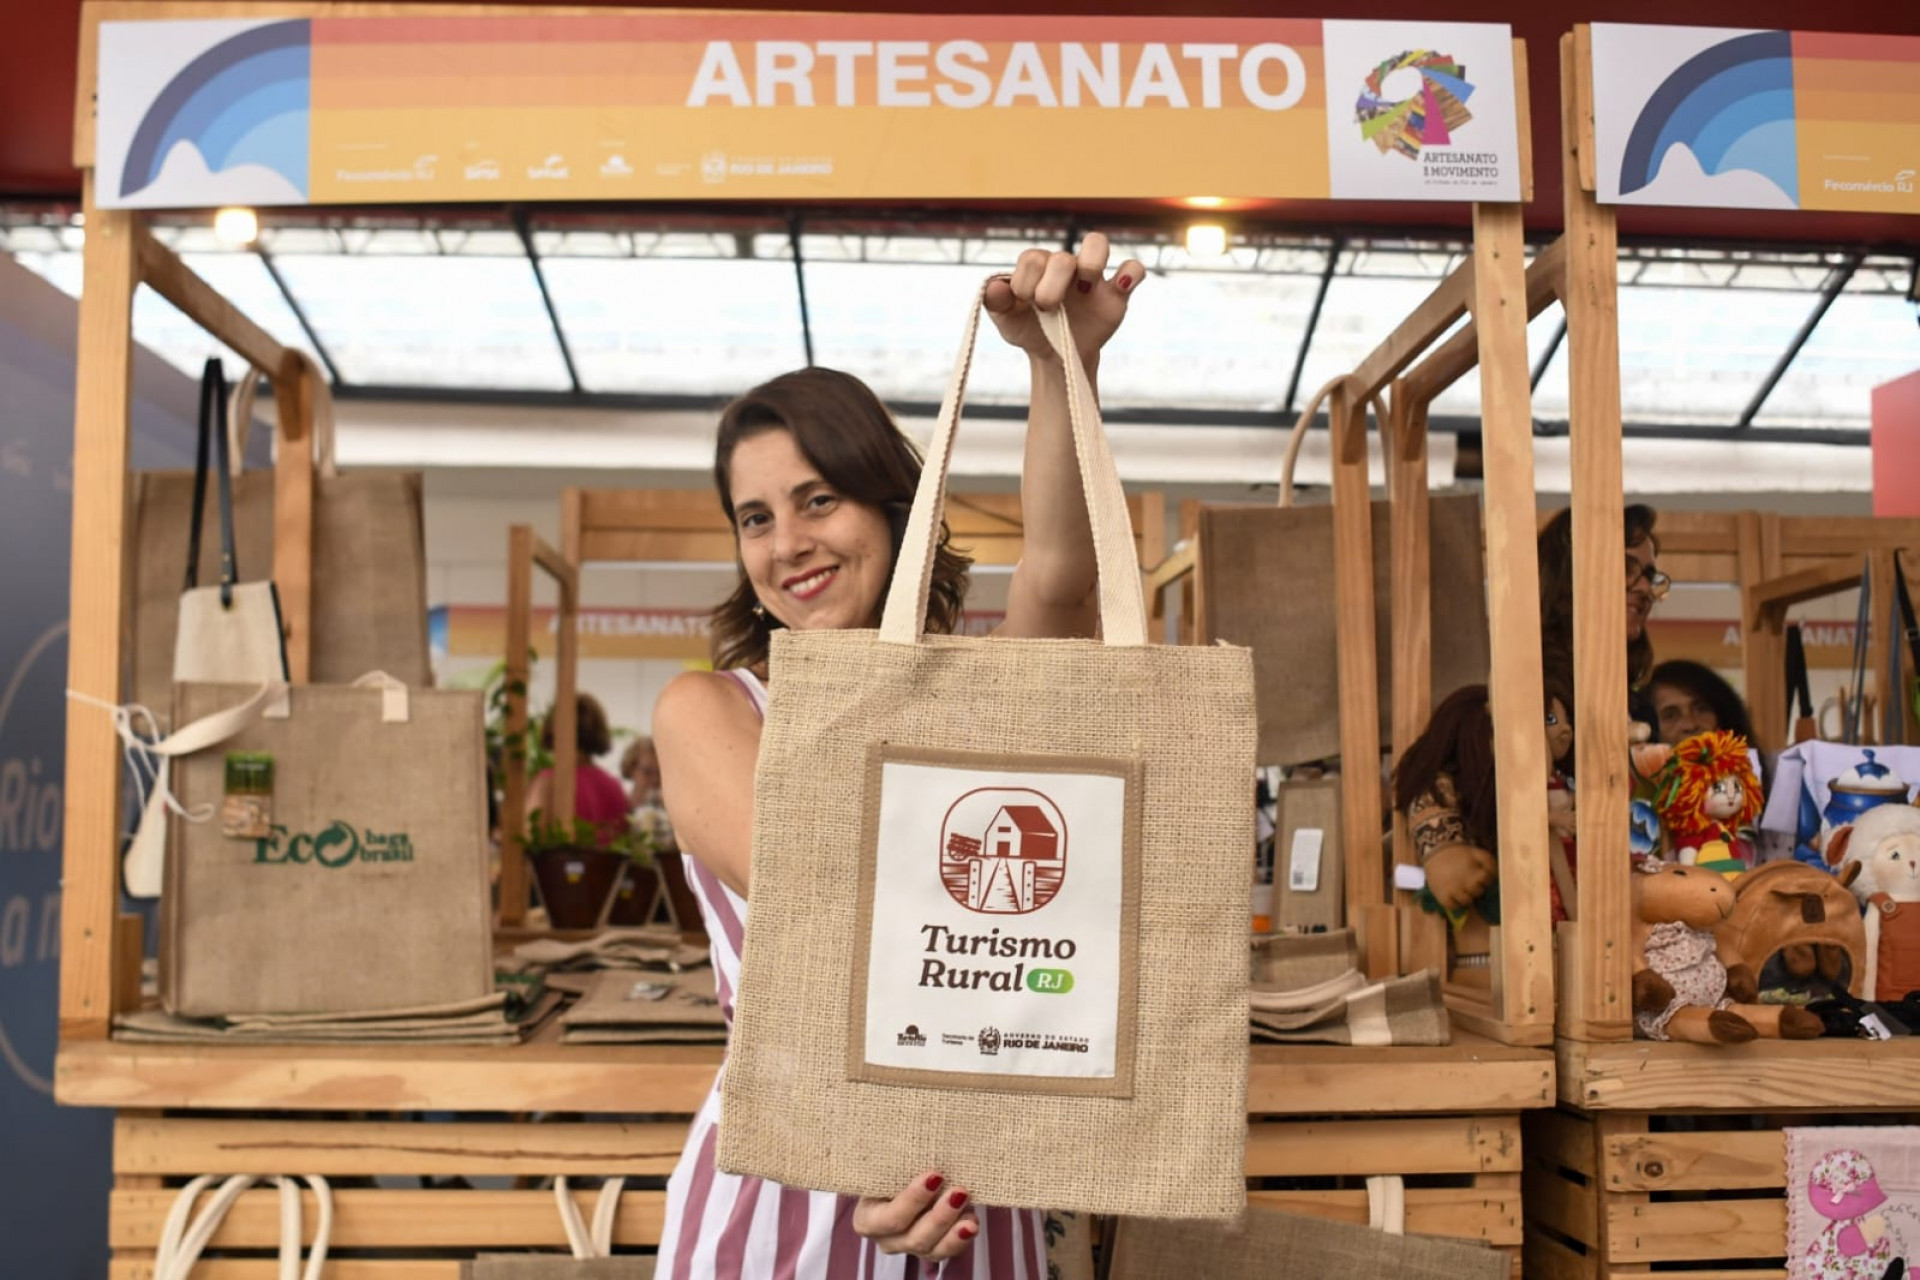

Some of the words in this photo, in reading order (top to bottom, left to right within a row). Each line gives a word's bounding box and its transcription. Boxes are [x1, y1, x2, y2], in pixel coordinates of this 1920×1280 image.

[687, 40, 1306, 111] ARTESANATO
[1423, 152, 1498, 164] ARTESANATO
[1431, 166, 1499, 178] MOVIMENTO
[1824, 178, 1895, 194] Fecomércio
[920, 923, 1077, 960] Turismo
[918, 958, 1025, 992] Rural
[1036, 972, 1065, 990] RJ
[1003, 1039, 1024, 1049] RIO
[1025, 1039, 1041, 1049] DE
[1041, 1040, 1089, 1054] JANEIRO
